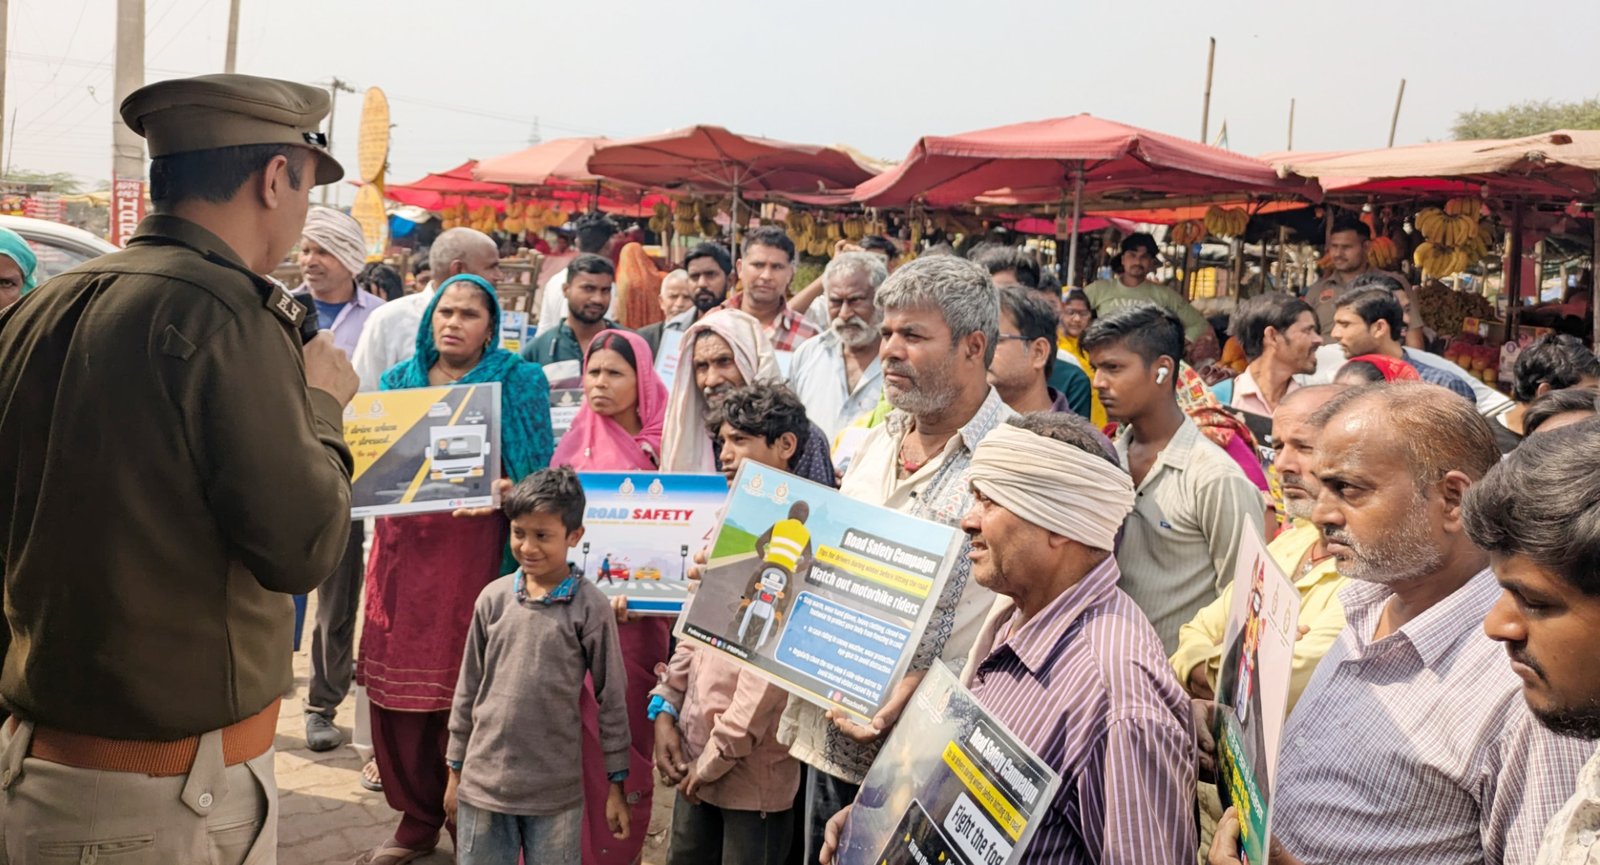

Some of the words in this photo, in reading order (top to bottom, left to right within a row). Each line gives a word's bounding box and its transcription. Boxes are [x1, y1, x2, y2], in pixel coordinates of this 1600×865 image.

[587, 507, 629, 519] ROAD
[632, 508, 694, 521] SAFETY
[844, 531, 869, 551] Road
[866, 539, 894, 561] Safety
[892, 548, 936, 574] Campaign
[809, 565, 837, 586] Watch
[835, 578, 852, 592] out
[850, 582, 894, 607] motorbike
[892, 595, 920, 616] riders
[880, 569, 894, 579] before
[909, 579, 917, 587] the
[917, 582, 928, 591] road
[969, 726, 990, 754] Road
[982, 739, 1007, 773] Safety
[1000, 757, 1039, 804] Campaign
[951, 804, 976, 839] Fight
[970, 826, 988, 856] the
[1004, 811, 1012, 823] the
[1010, 818, 1021, 833] road
